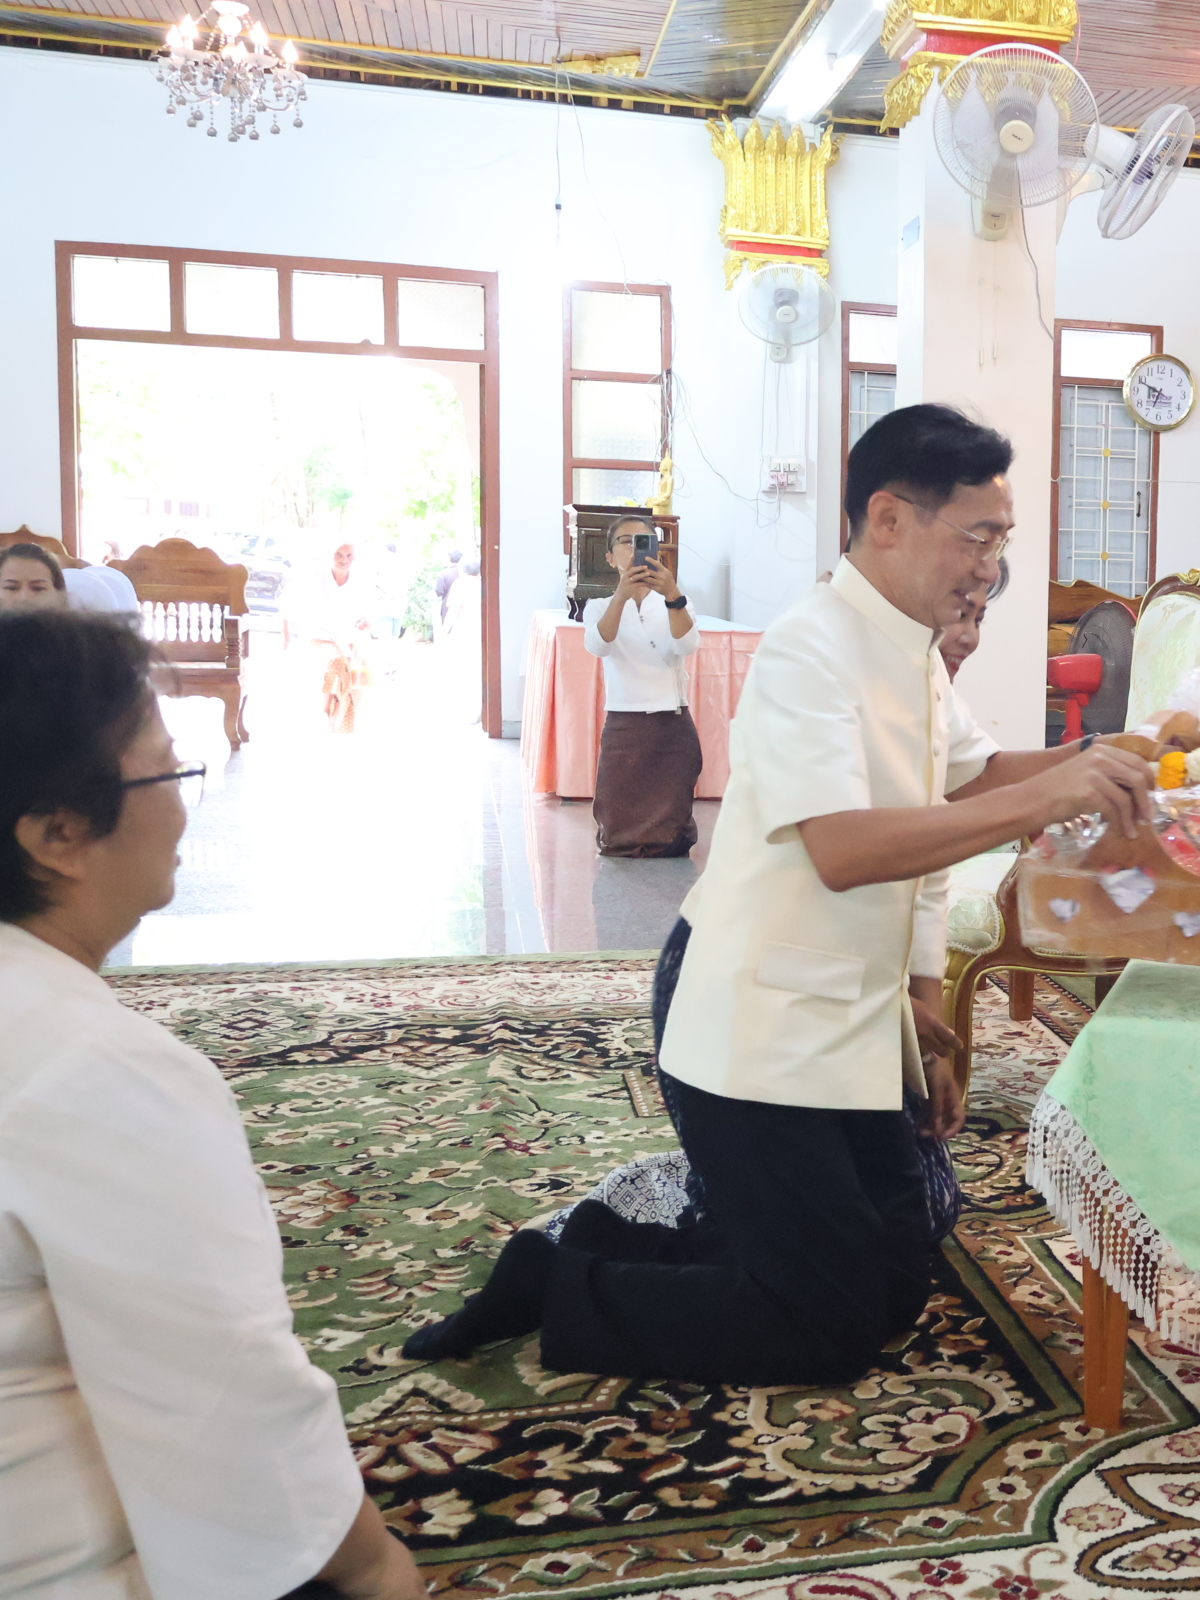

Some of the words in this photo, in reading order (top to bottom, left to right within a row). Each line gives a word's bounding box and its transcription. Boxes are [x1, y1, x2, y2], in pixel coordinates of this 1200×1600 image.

[1156, 364, 1166, 375] 12
[1169, 368, 1173, 378] 1
[1176, 377, 1183, 387] 2
[1132, 386, 1140, 396] 9
[1179, 391, 1186, 400] 3
[1136, 399, 1143, 409] 8
[1175, 403, 1182, 412] 4
[1145, 408, 1151, 417] 7
[1155, 412, 1162, 421] 6
[1166, 410, 1173, 420] 5
